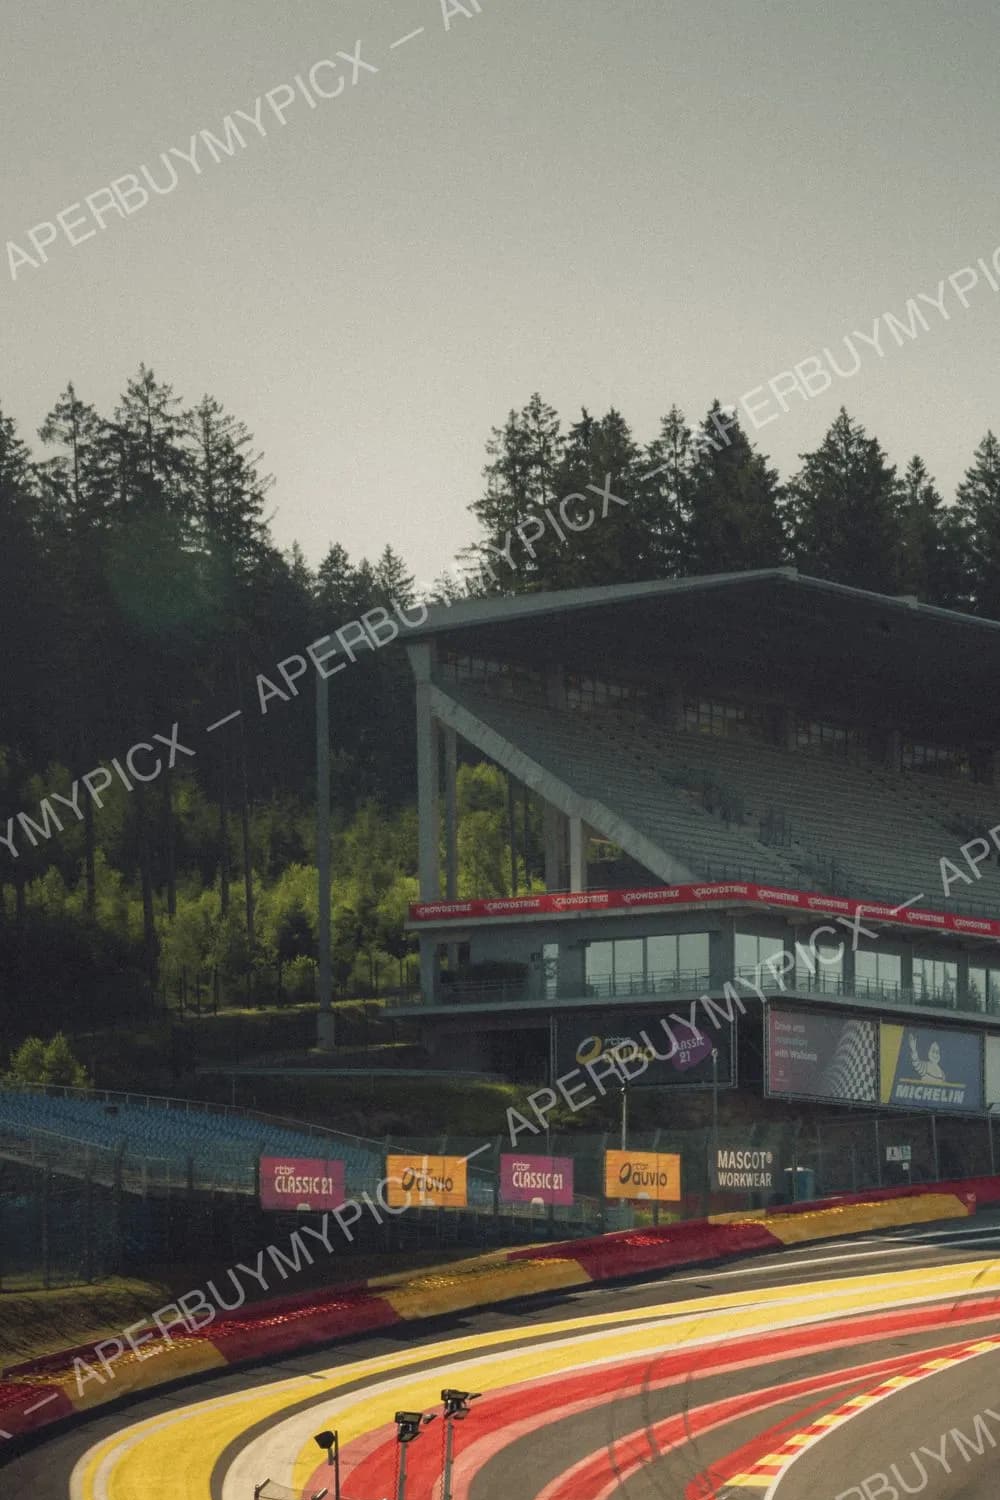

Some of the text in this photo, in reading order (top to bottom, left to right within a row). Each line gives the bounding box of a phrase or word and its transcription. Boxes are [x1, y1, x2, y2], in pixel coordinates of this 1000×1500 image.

[627, 889, 679, 901] CROWDSTRIKE
[697, 885, 747, 897] CROWDSTRIKE
[487, 899, 540, 911] CROWDSTRIKE
[556, 894, 609, 905] CROWDSTRIKE
[674, 1037, 705, 1051] LASSIC
[680, 1051, 692, 1063] 21
[895, 1085, 965, 1104] MICHELIN
[274, 1176, 333, 1195] CLASSIC 21
[512, 1171, 564, 1190] CLASSIC 21
[632, 1171, 668, 1187] auvio
[718, 1172, 772, 1187] WORKWEAR
